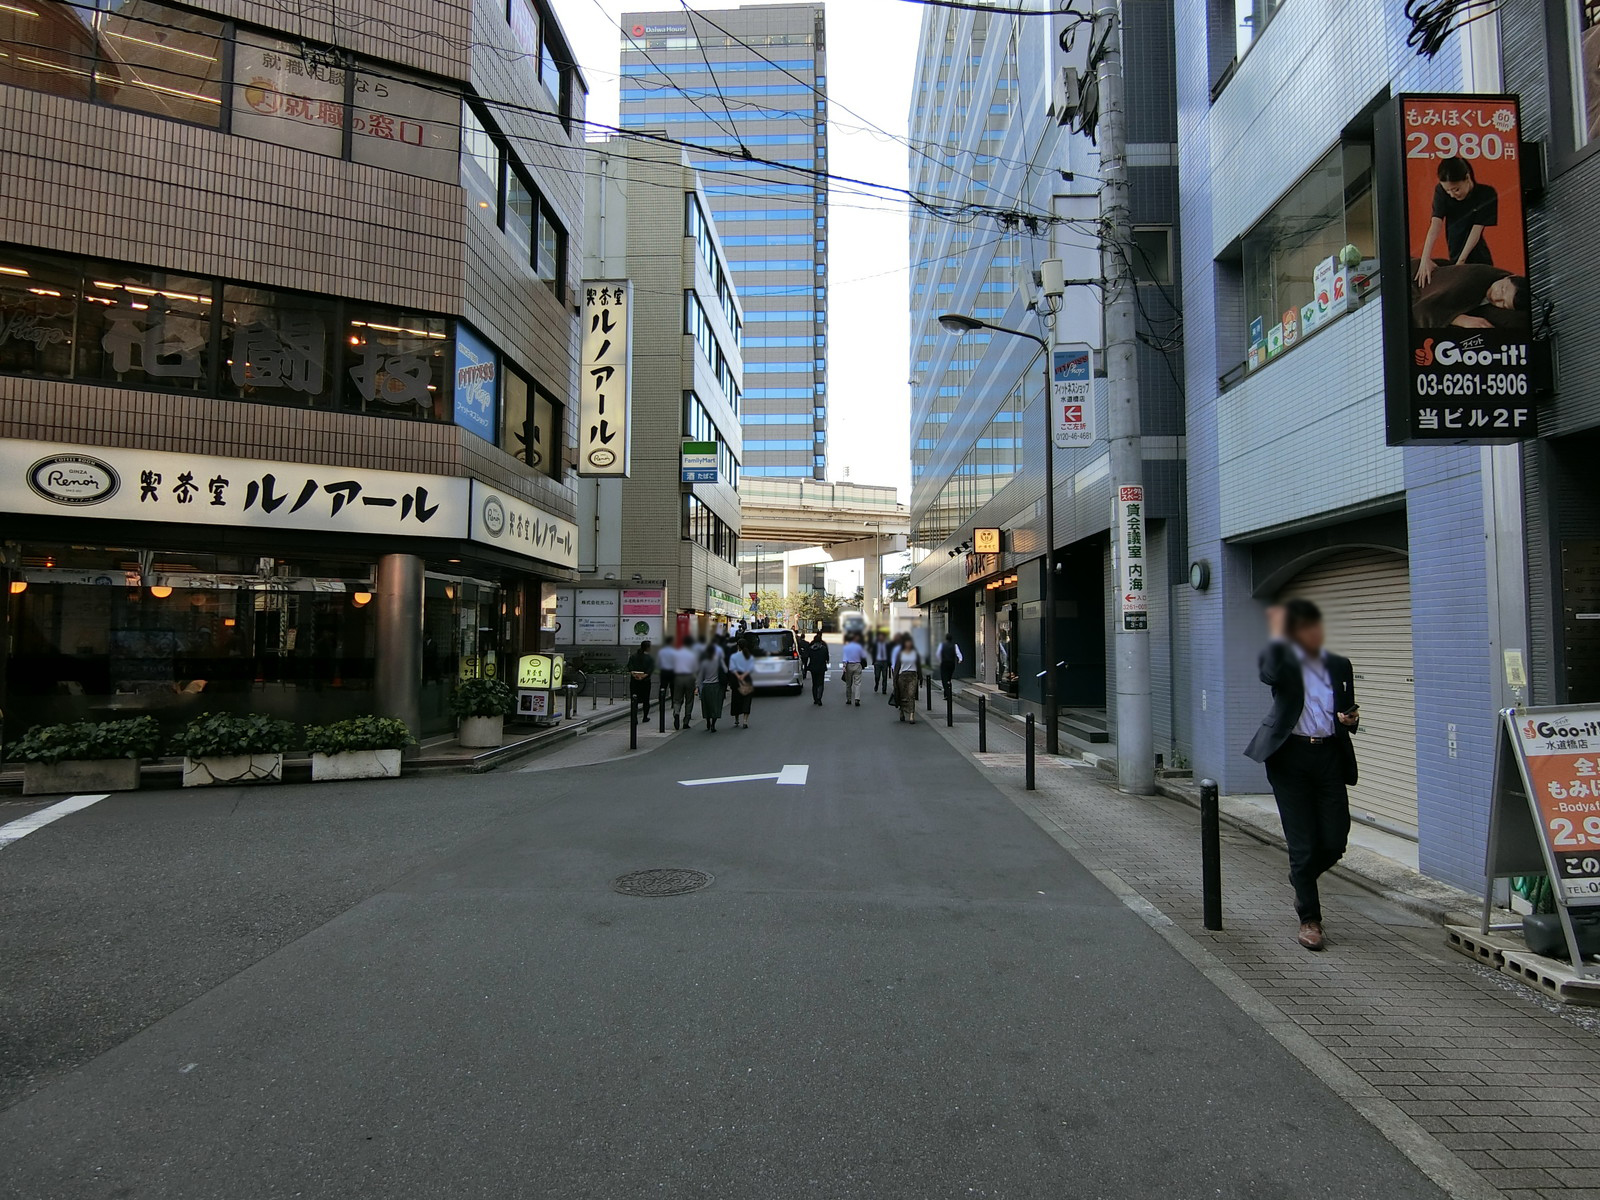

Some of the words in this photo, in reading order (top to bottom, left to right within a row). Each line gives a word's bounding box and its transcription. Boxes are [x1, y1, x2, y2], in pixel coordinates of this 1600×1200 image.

[285, 91, 423, 147] 就職の窓口
[1406, 108, 1492, 127] もみほぐし
[1497, 112, 1510, 121] 60
[586, 287, 624, 307] 喫茶室
[1434, 341, 1527, 366] Goo-it!
[590, 308, 617, 445] ルノアール
[1416, 373, 1528, 396] 03-6261-5906
[1060, 422, 1087, 430] ここ左折
[140, 469, 230, 506] 喫茶室
[243, 473, 440, 523] ルノアール
[531, 517, 572, 556] ルノアール
[1126, 503, 1142, 559] 貸会議室
[1128, 563, 1143, 591] 内海
[1546, 739, 1588, 750] 水道橋店
[1573, 757, 1600, 776] 全
[1565, 856, 1600, 874] この
